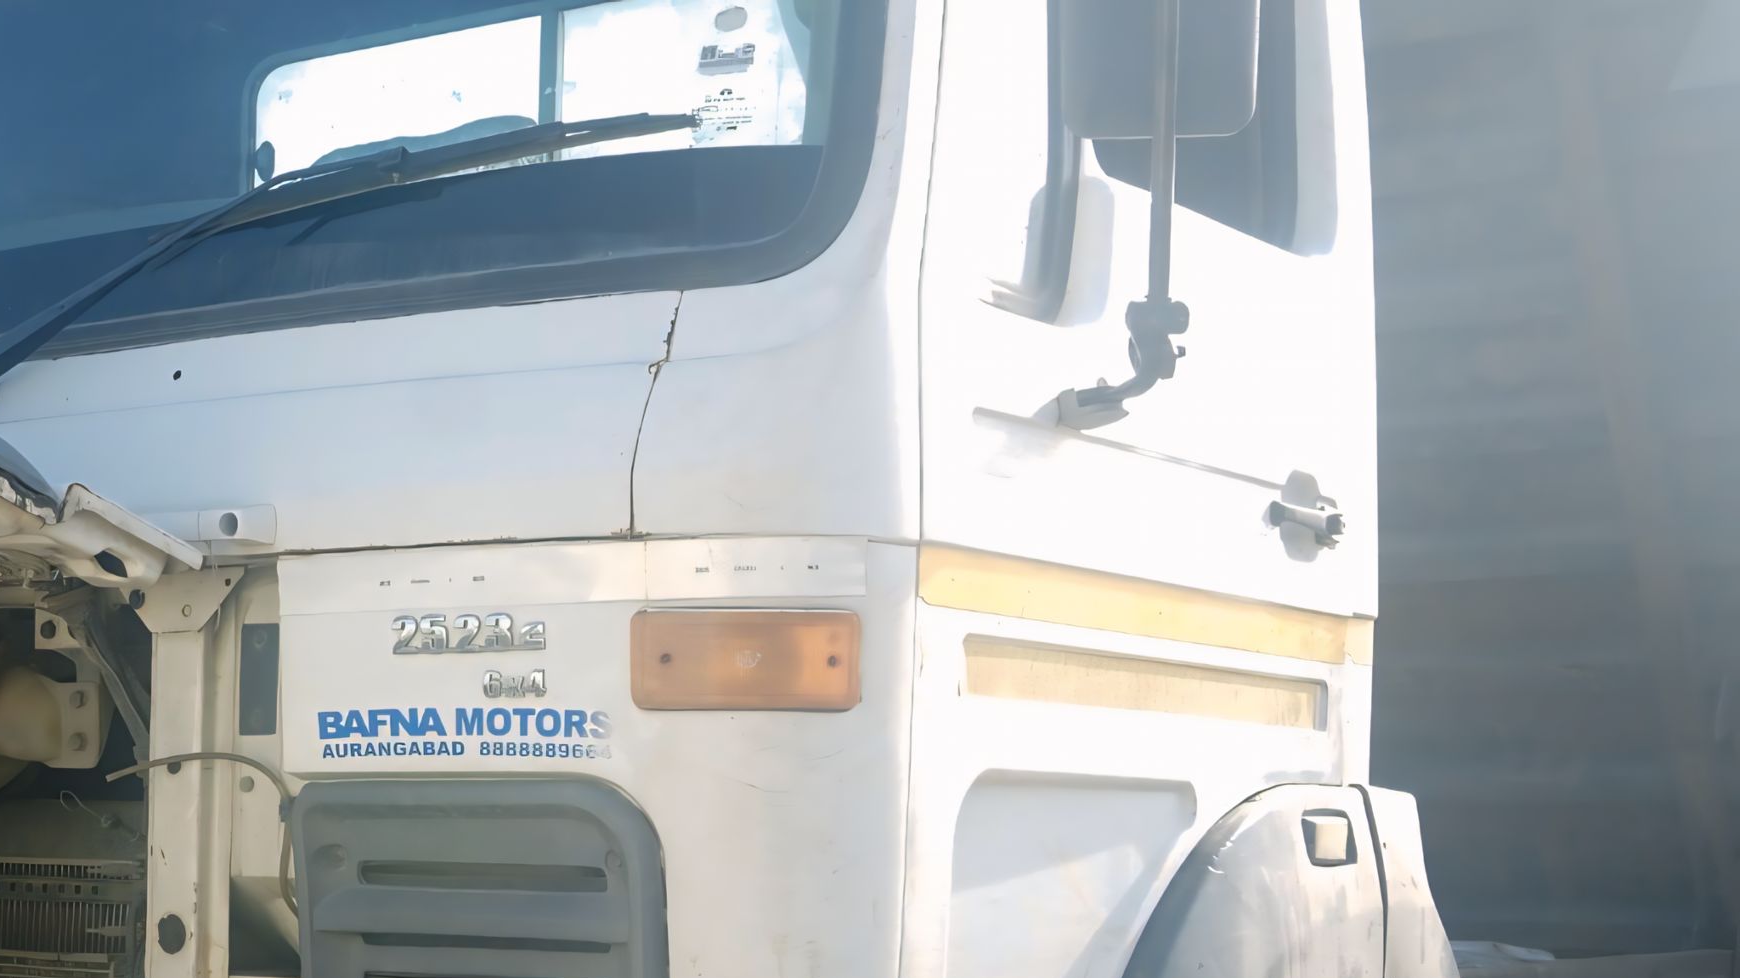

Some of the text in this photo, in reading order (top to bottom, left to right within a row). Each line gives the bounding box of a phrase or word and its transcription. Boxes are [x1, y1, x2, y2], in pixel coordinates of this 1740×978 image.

[317, 708, 612, 740] BAFNA MOTORS
[322, 741, 465, 759] AURANGABAD
